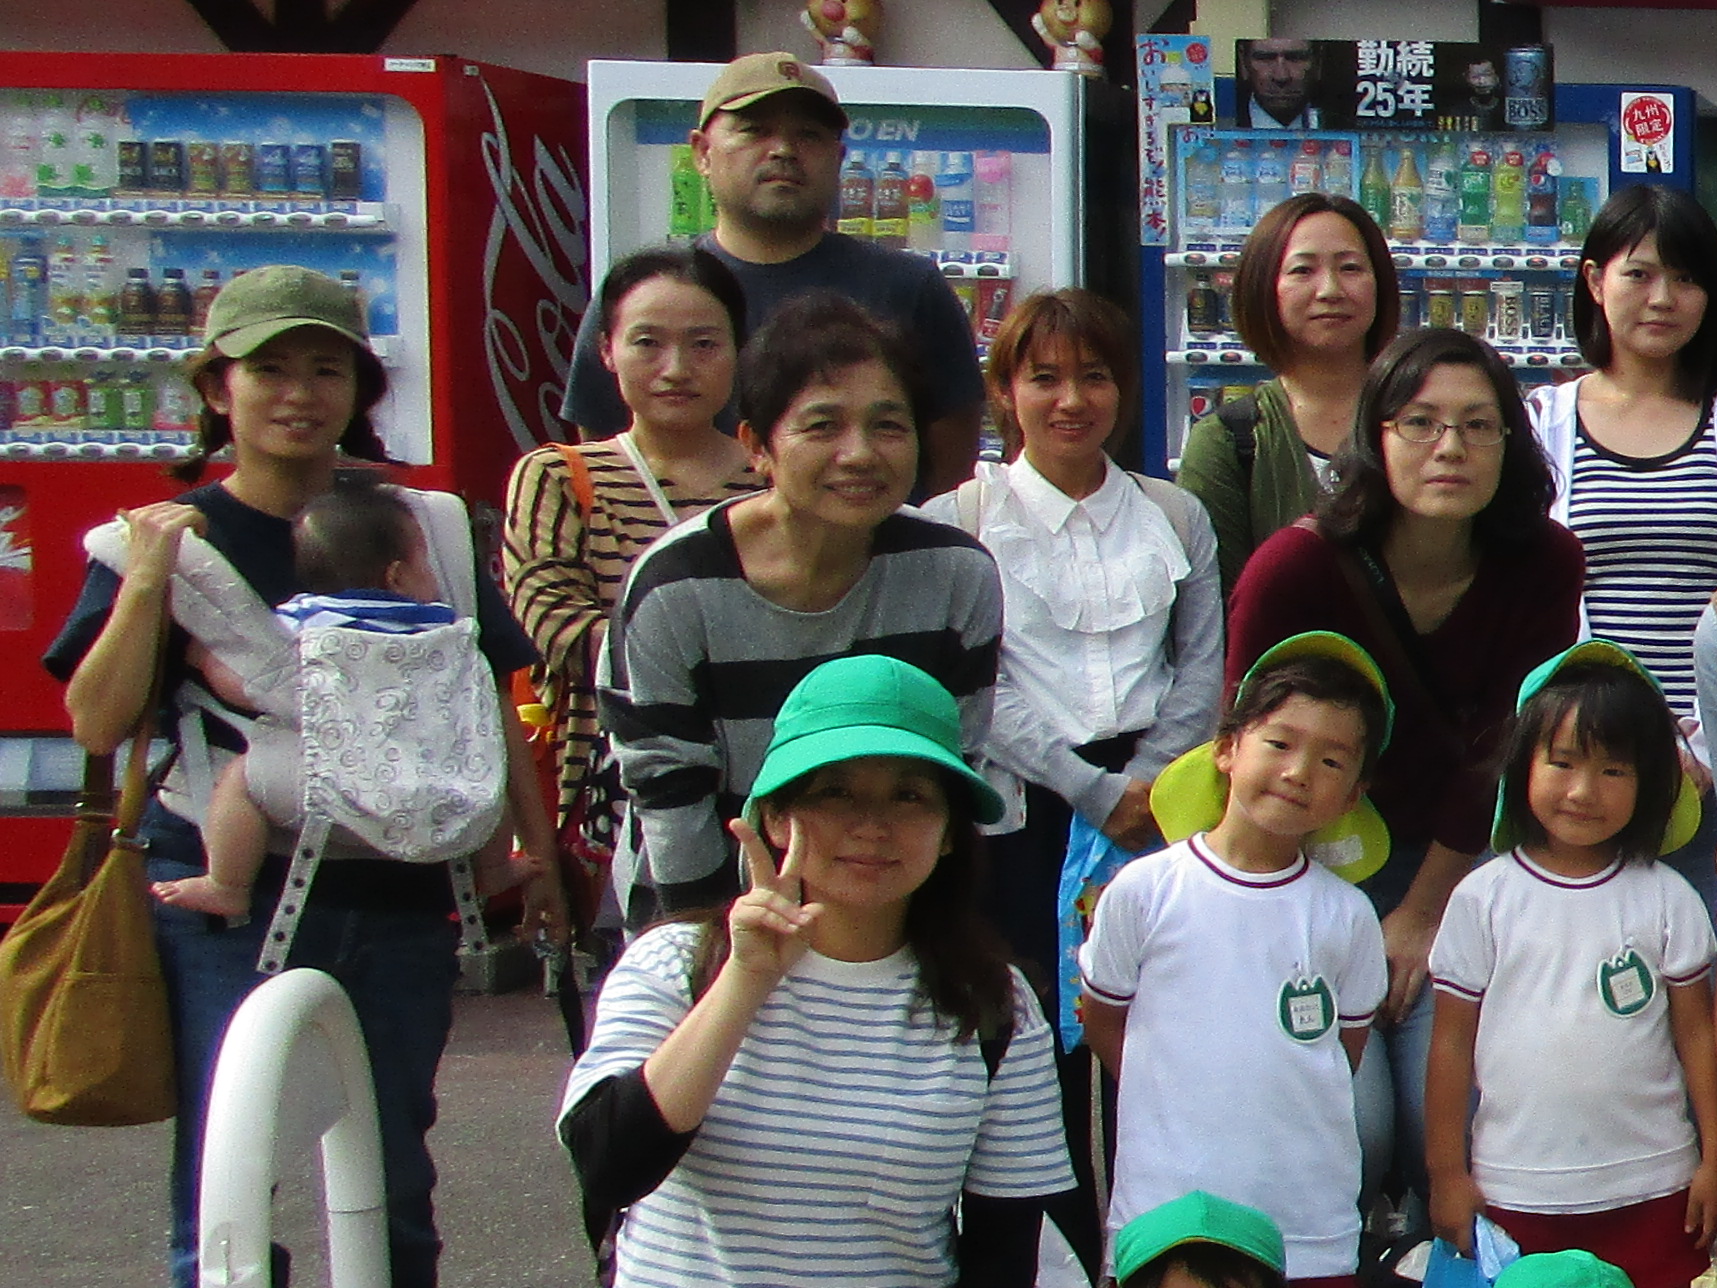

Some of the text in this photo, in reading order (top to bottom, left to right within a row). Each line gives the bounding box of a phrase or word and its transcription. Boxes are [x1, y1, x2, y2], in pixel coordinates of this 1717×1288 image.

[1356, 40, 1435, 78] 勤続
[1355, 80, 1435, 118] 25年
[1507, 102, 1547, 119] BOSS
[1633, 103, 1660, 122] 九州
[876, 119, 920, 142] EN
[1635, 118, 1664, 136] 限定
[1504, 295, 1519, 338] BOSS
